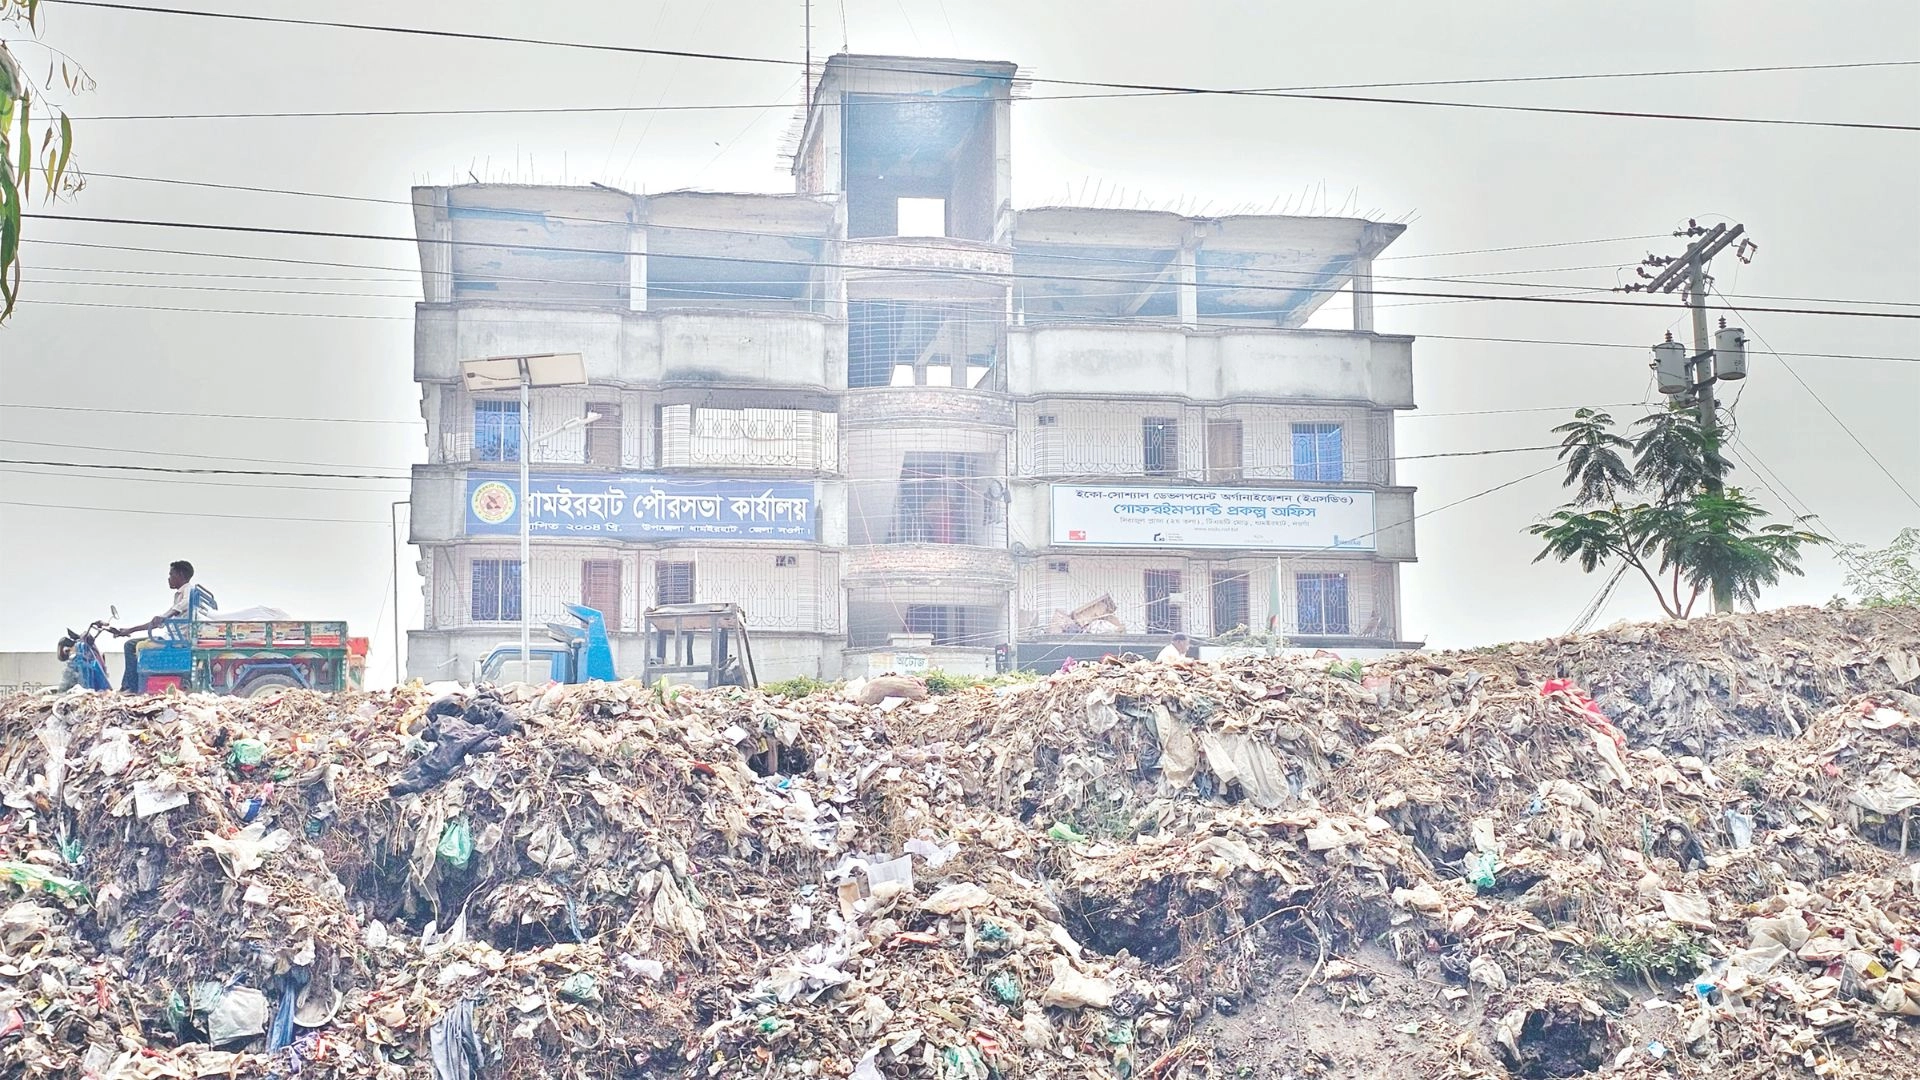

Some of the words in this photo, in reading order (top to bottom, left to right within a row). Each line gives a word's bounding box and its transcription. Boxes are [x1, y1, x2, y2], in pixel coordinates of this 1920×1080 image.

[632, 485, 725, 520] পৌরসভা
[728, 488, 810, 522] কার্যালয়
[1075, 489, 1149, 500] ইকো-সোশ্যাল
[1220, 492, 1292, 503] অর্গানাইজেশন
[1296, 493, 1354, 506] (ইএসডিও)
[1226, 504, 1267, 519] প্রকল্প
[1271, 504, 1317, 518] অফিস
[566, 522, 601, 533] ২০০৪
[641, 522, 684, 533] উপজেলা
[748, 526, 774, 535] জেলা
